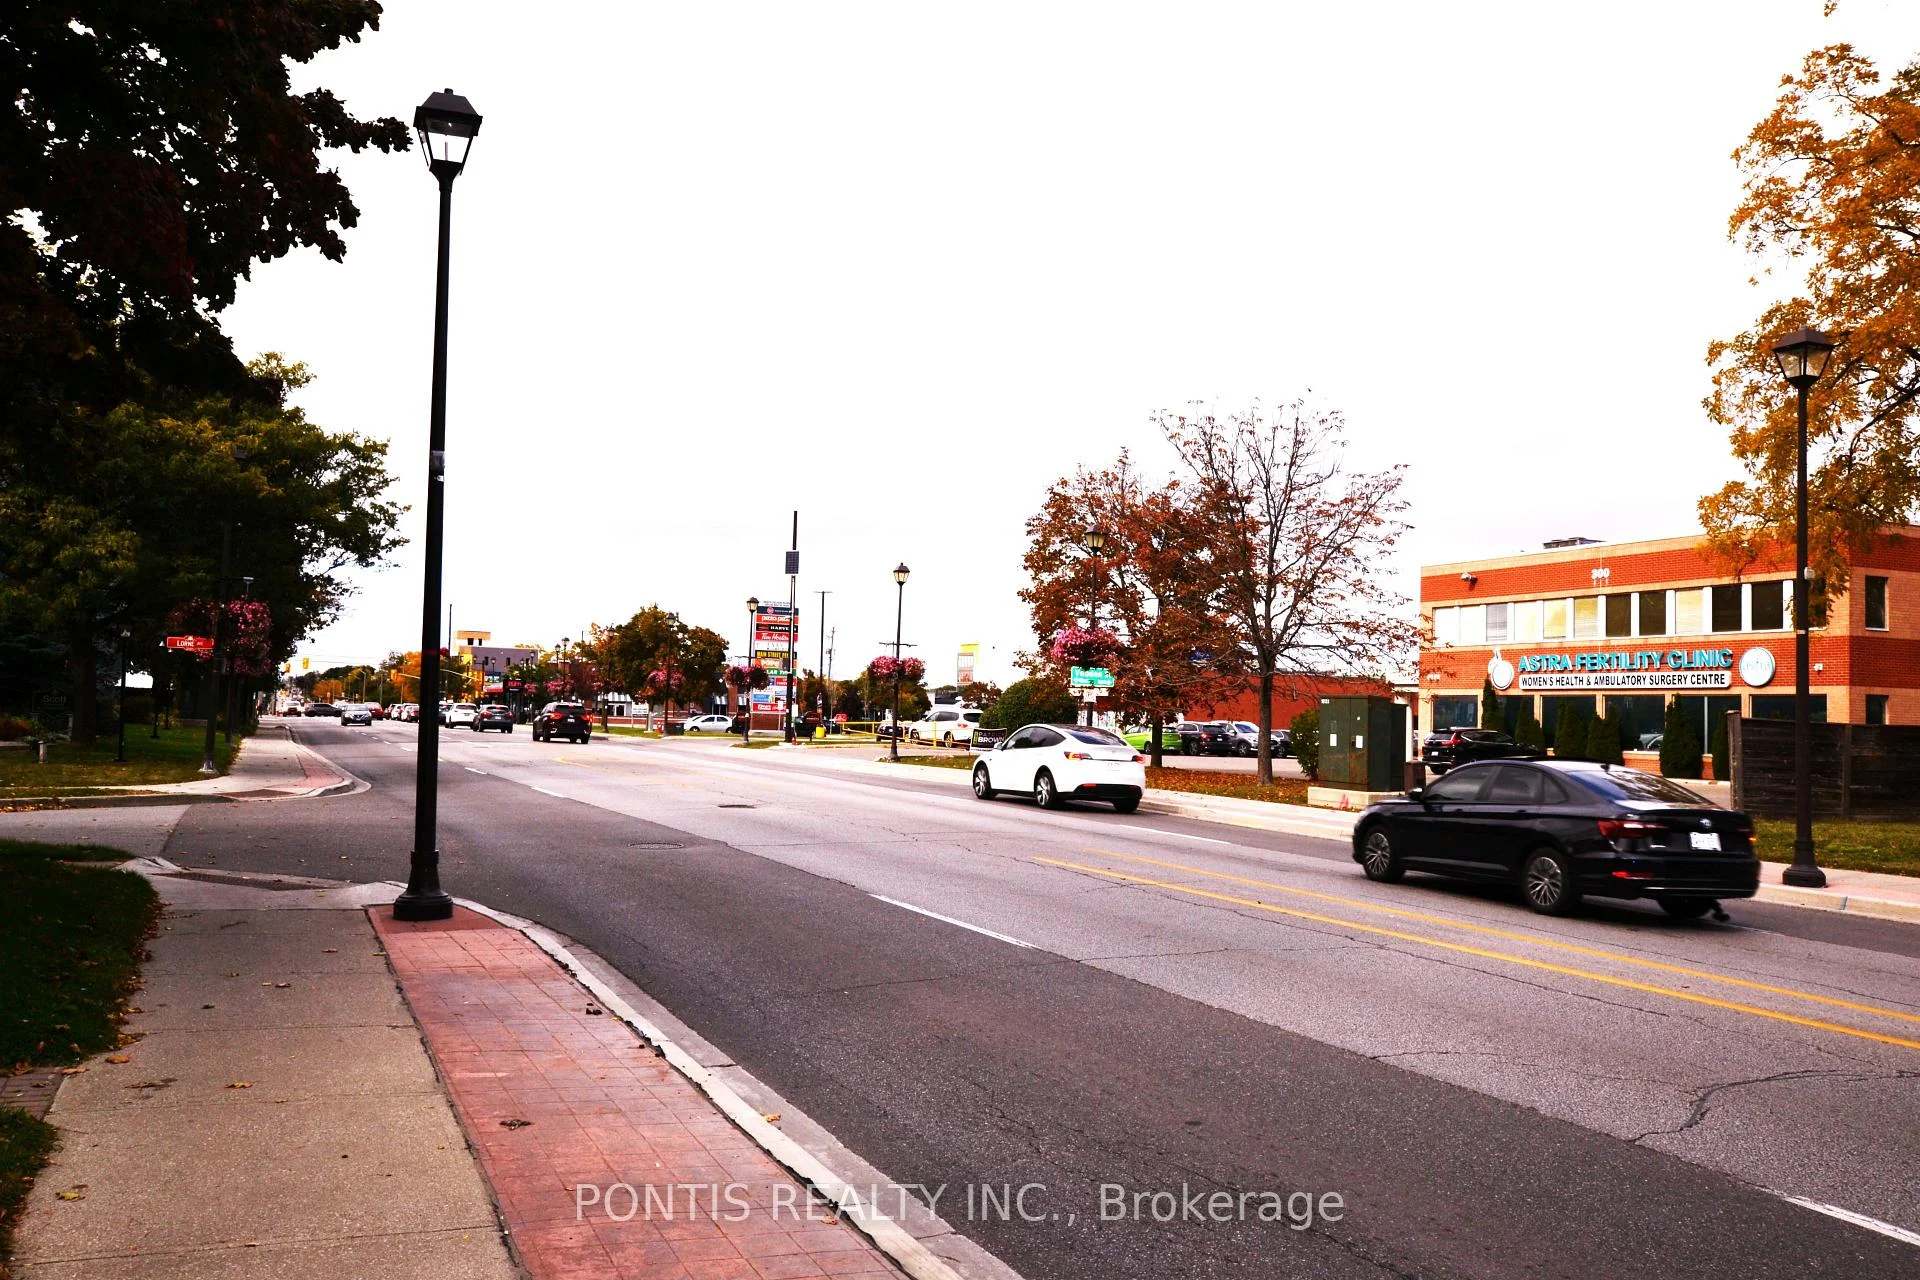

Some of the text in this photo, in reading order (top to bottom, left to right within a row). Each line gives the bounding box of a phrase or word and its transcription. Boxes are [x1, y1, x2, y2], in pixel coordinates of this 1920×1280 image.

[1518, 649, 1734, 672] ASTRA FERTILITY CLINIC
[1521, 673, 1726, 687] WOMEN'S HEALTH & AMBULATORY SURGERY CENTRE
